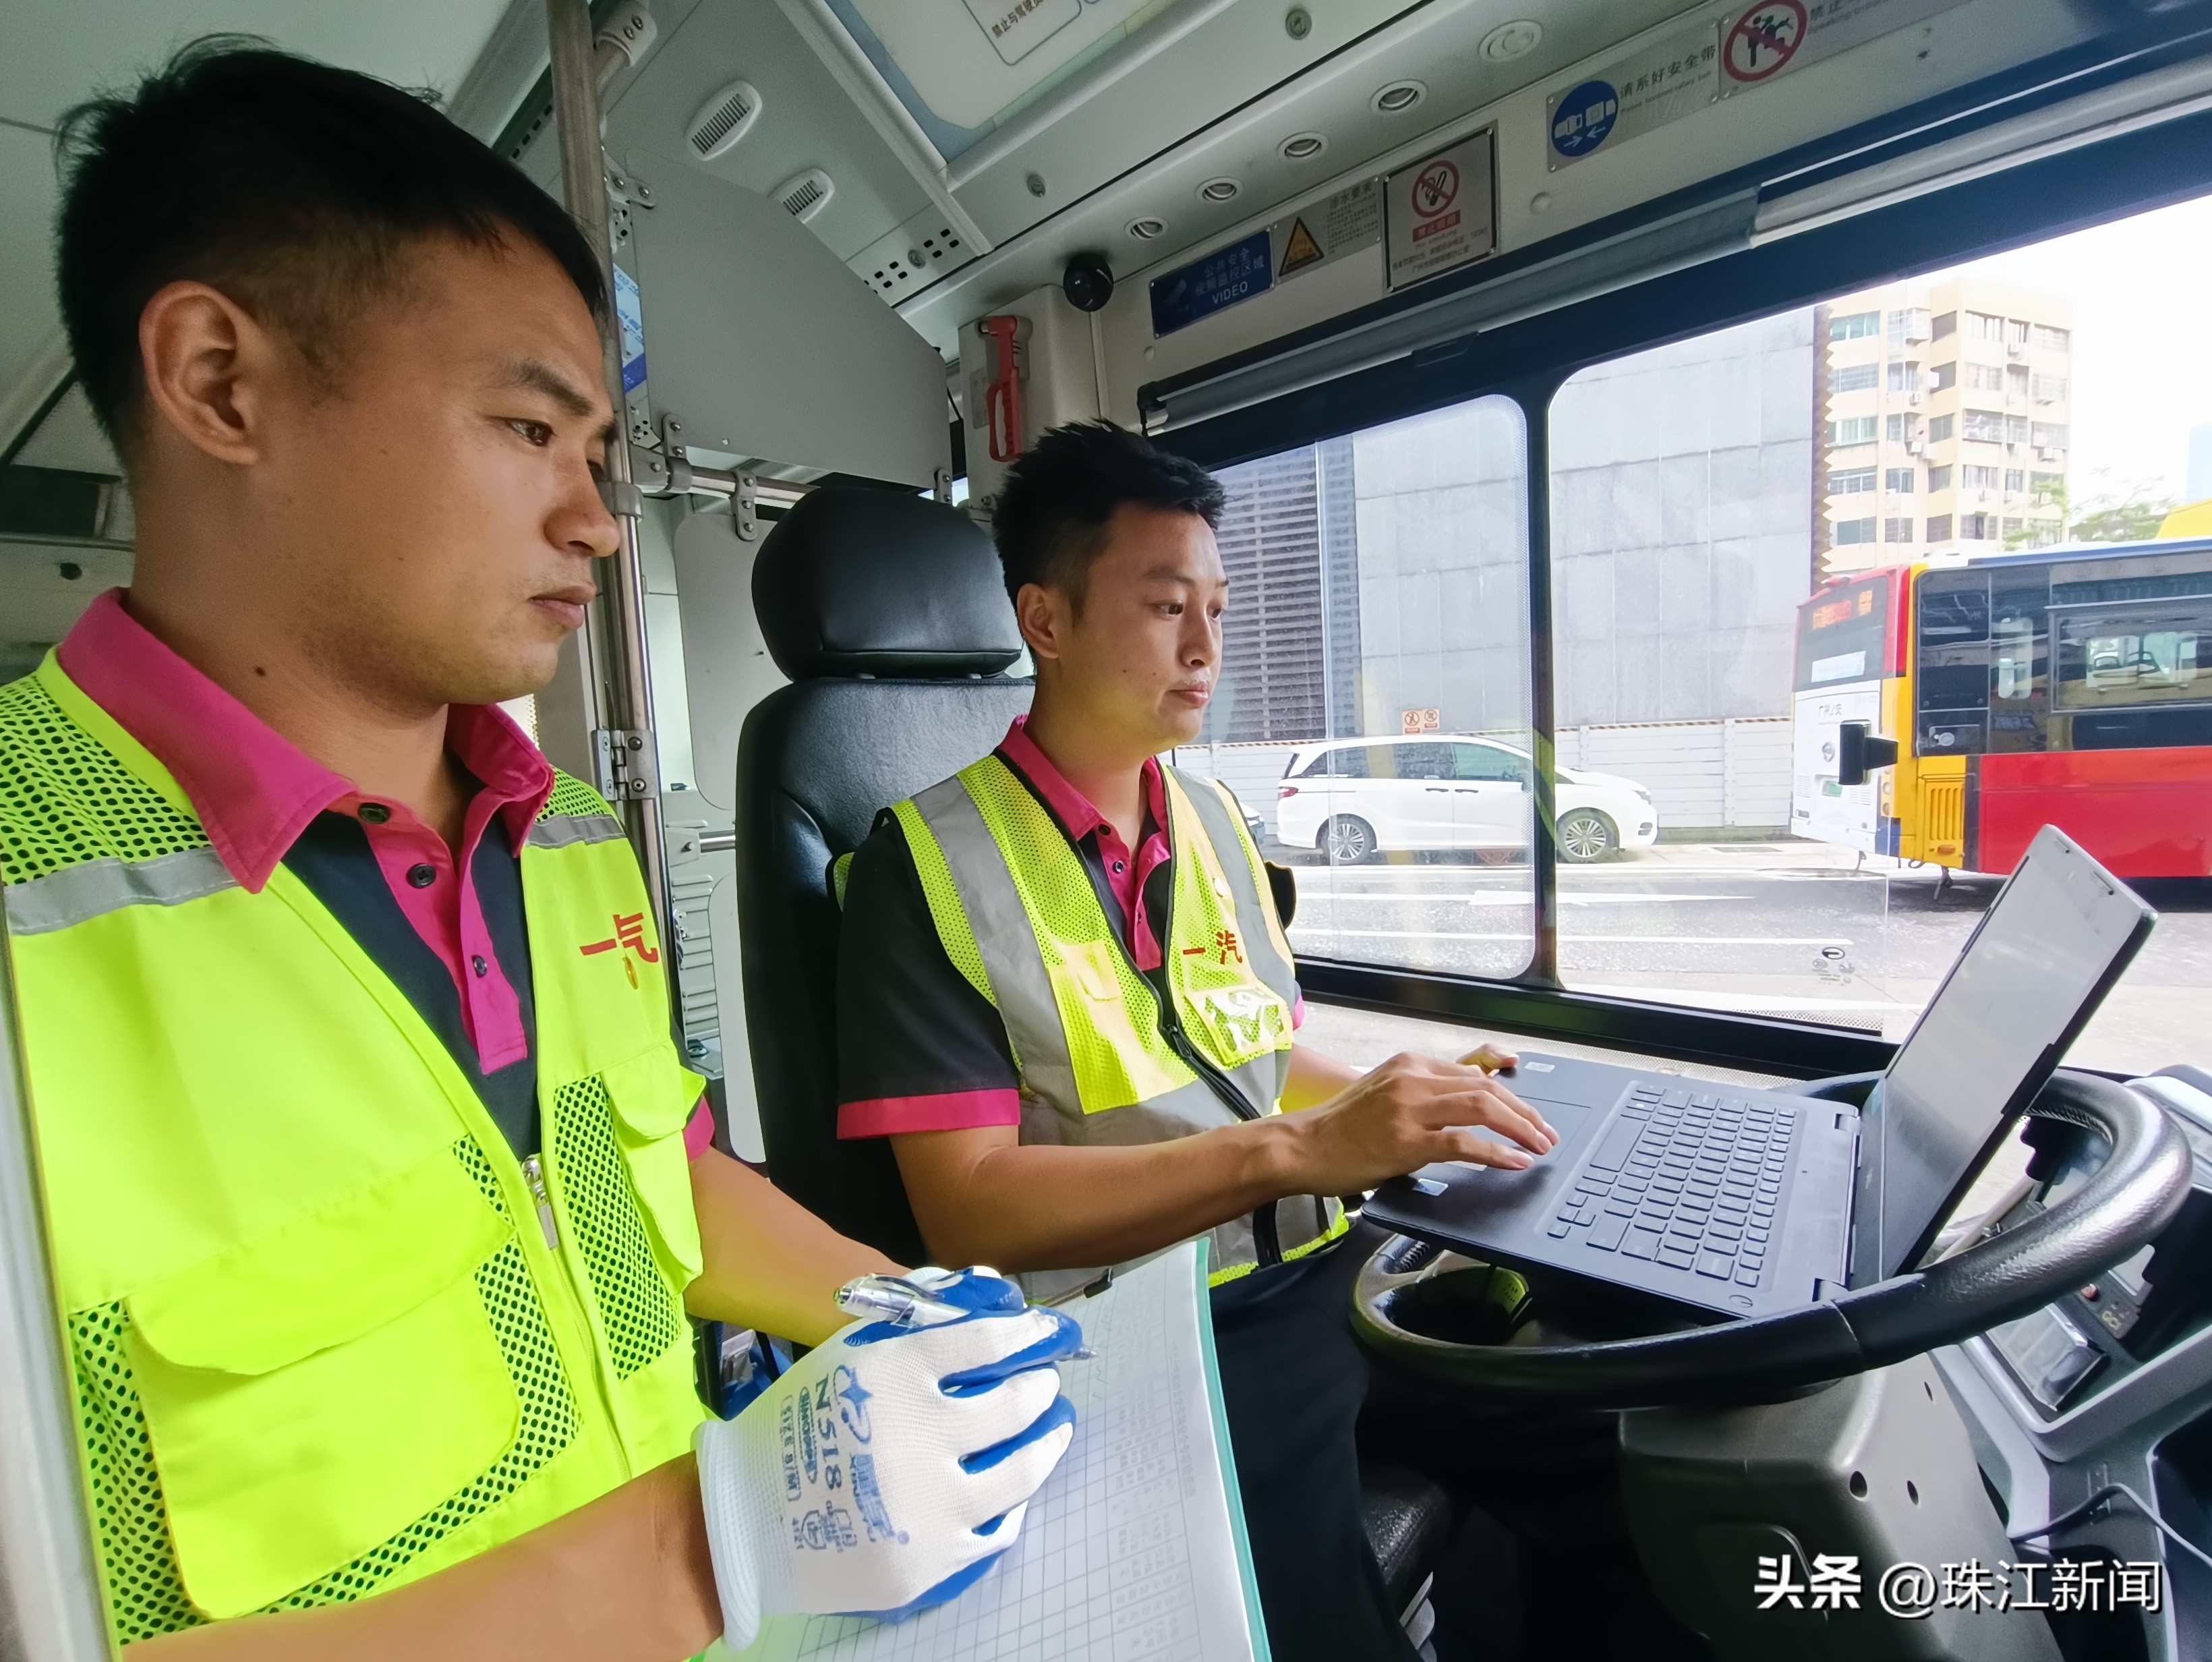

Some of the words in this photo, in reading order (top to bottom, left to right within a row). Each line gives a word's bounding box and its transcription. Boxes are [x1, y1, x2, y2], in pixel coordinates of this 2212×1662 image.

[1620, 45, 1716, 99] 请系好安全带
[1196, 255, 1265, 297] 视频监控区域
[1204, 248, 1250, 279] 公共安全
[1212, 281, 1248, 304] VIDEO
[1182, 930, 1242, 965] 一汽
[780, 1405, 793, 1445] SIZE
[815, 1373, 842, 1490] N518
